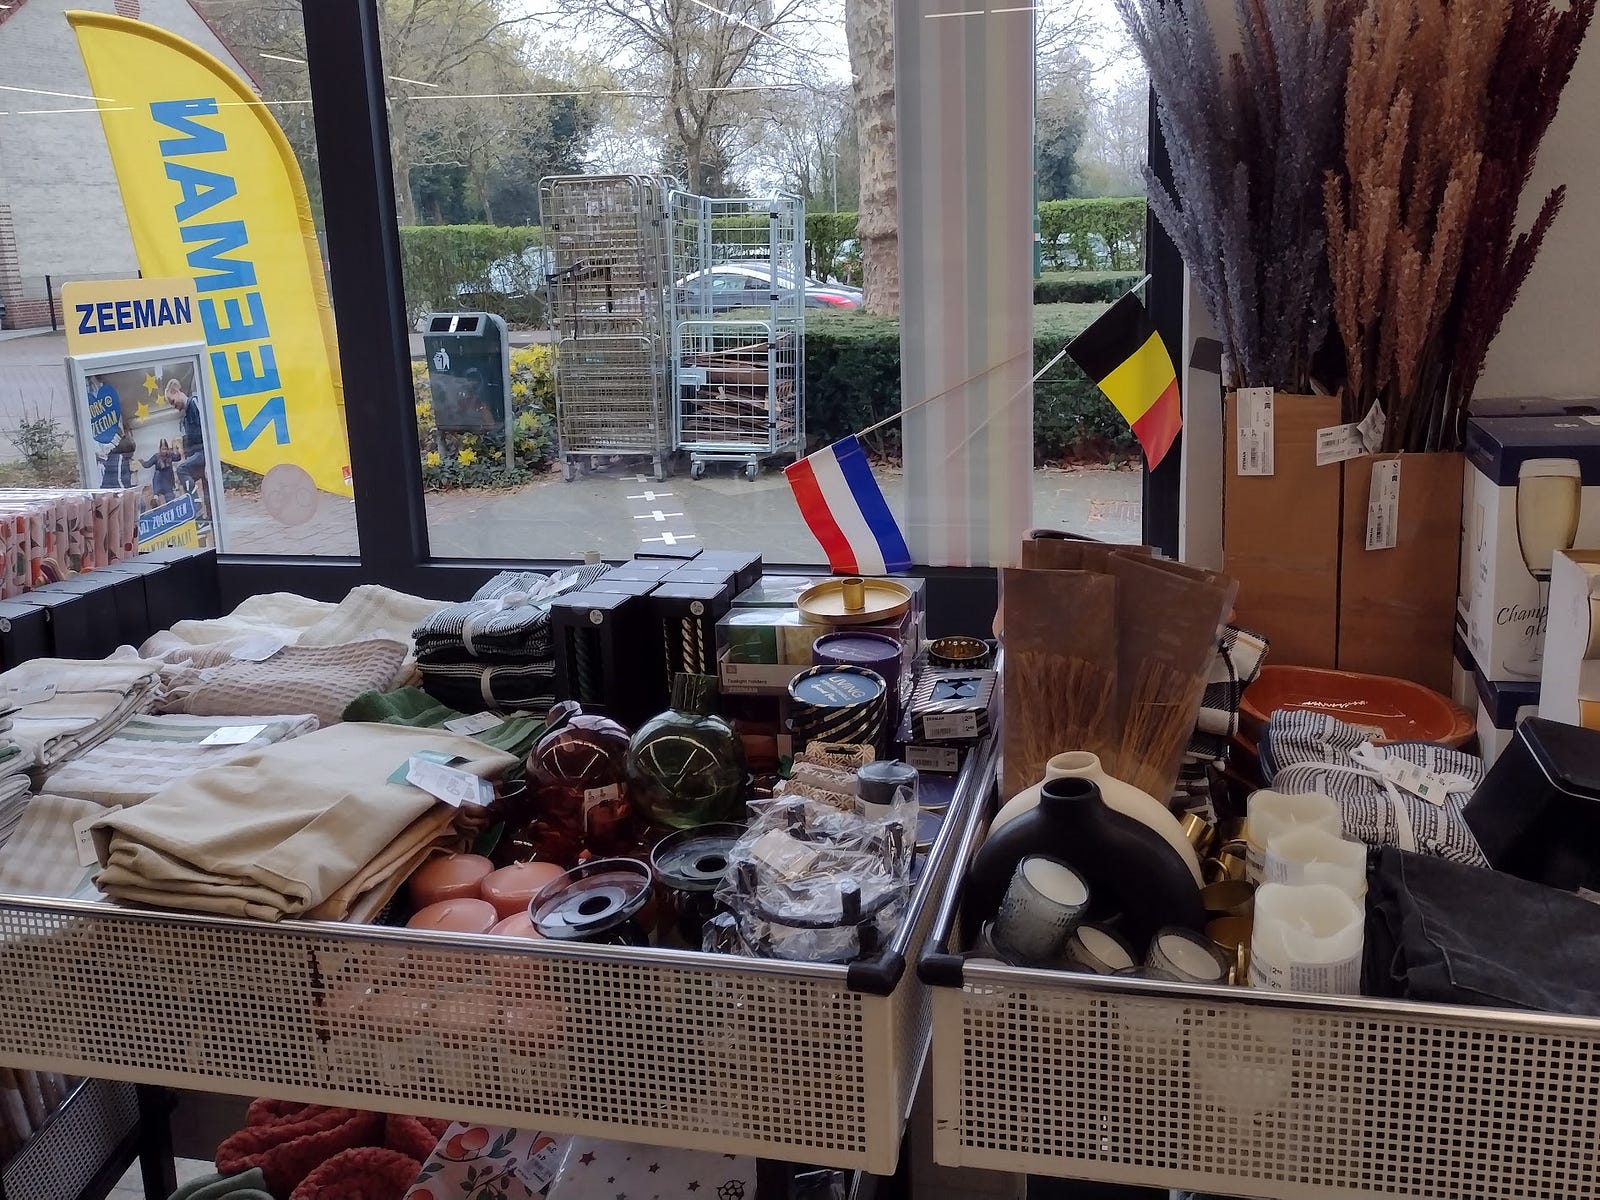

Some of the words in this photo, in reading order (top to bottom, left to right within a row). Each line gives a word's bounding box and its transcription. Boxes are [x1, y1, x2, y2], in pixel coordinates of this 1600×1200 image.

[75, 296, 192, 335] ZEEMAN
[89, 398, 106, 418] ORK
[1496, 604, 1548, 626] Champ
[828, 675, 866, 699] LIVING
